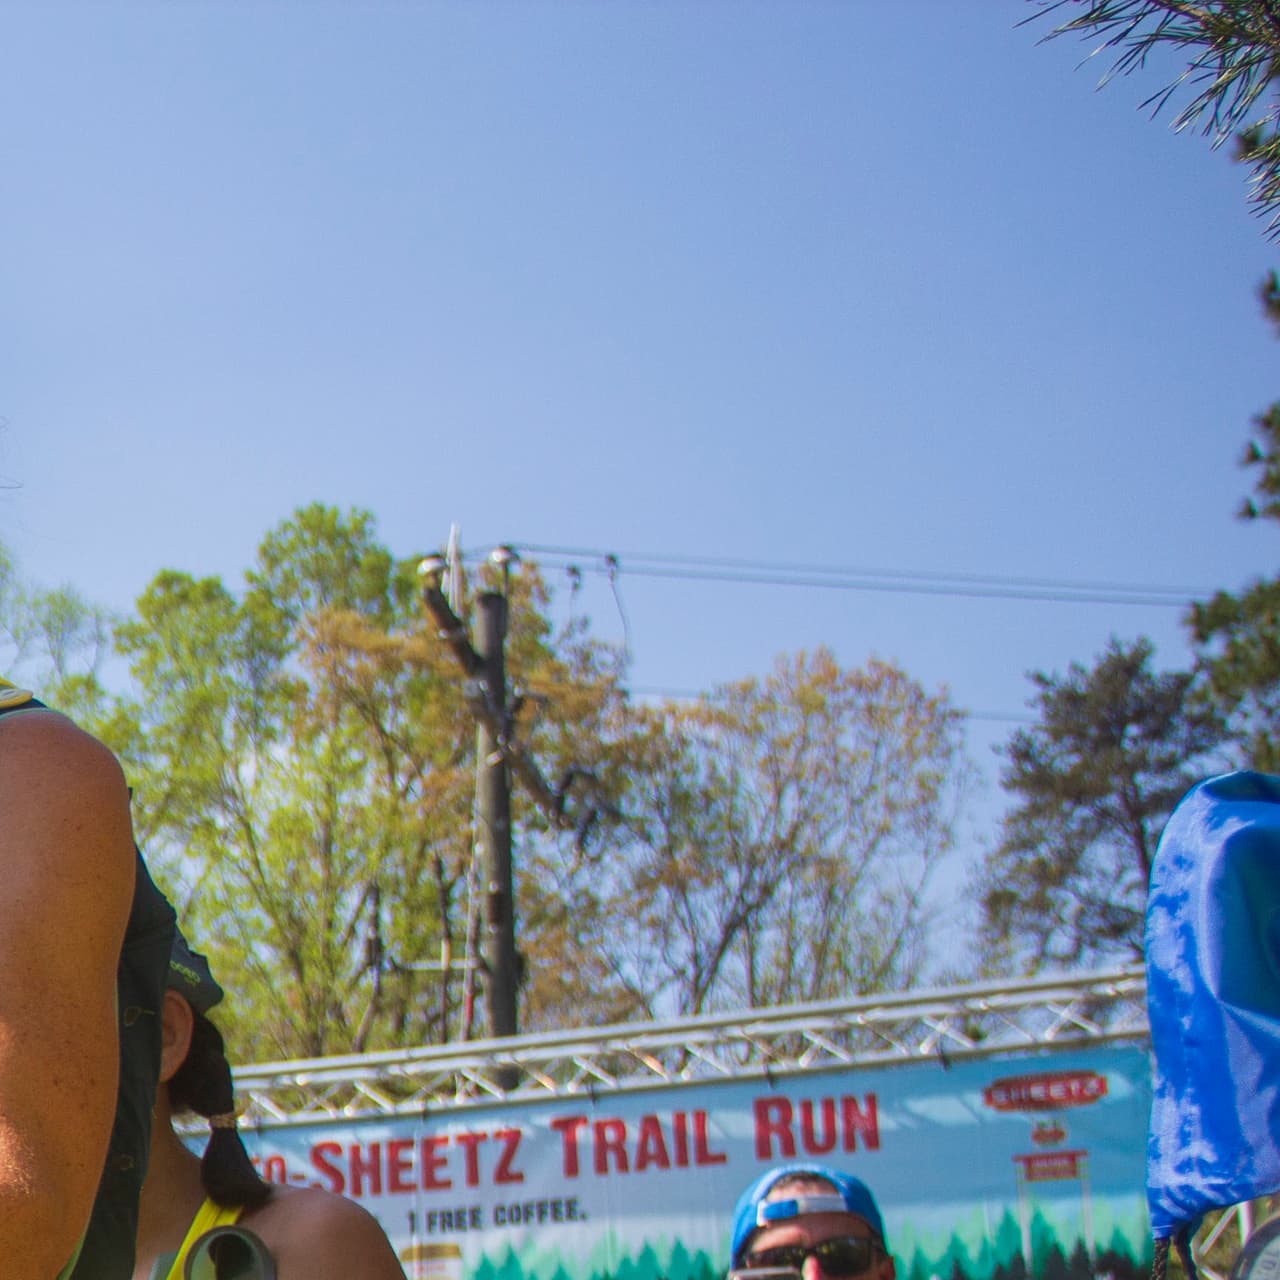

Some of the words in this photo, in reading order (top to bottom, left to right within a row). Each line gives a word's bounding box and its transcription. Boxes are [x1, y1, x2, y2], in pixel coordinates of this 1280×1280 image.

[550, 1110, 728, 1179] TRAIL
[751, 1092, 881, 1161] RUN
[426, 1206, 482, 1235] FREE
[493, 1195, 588, 1227] COFFEE.
